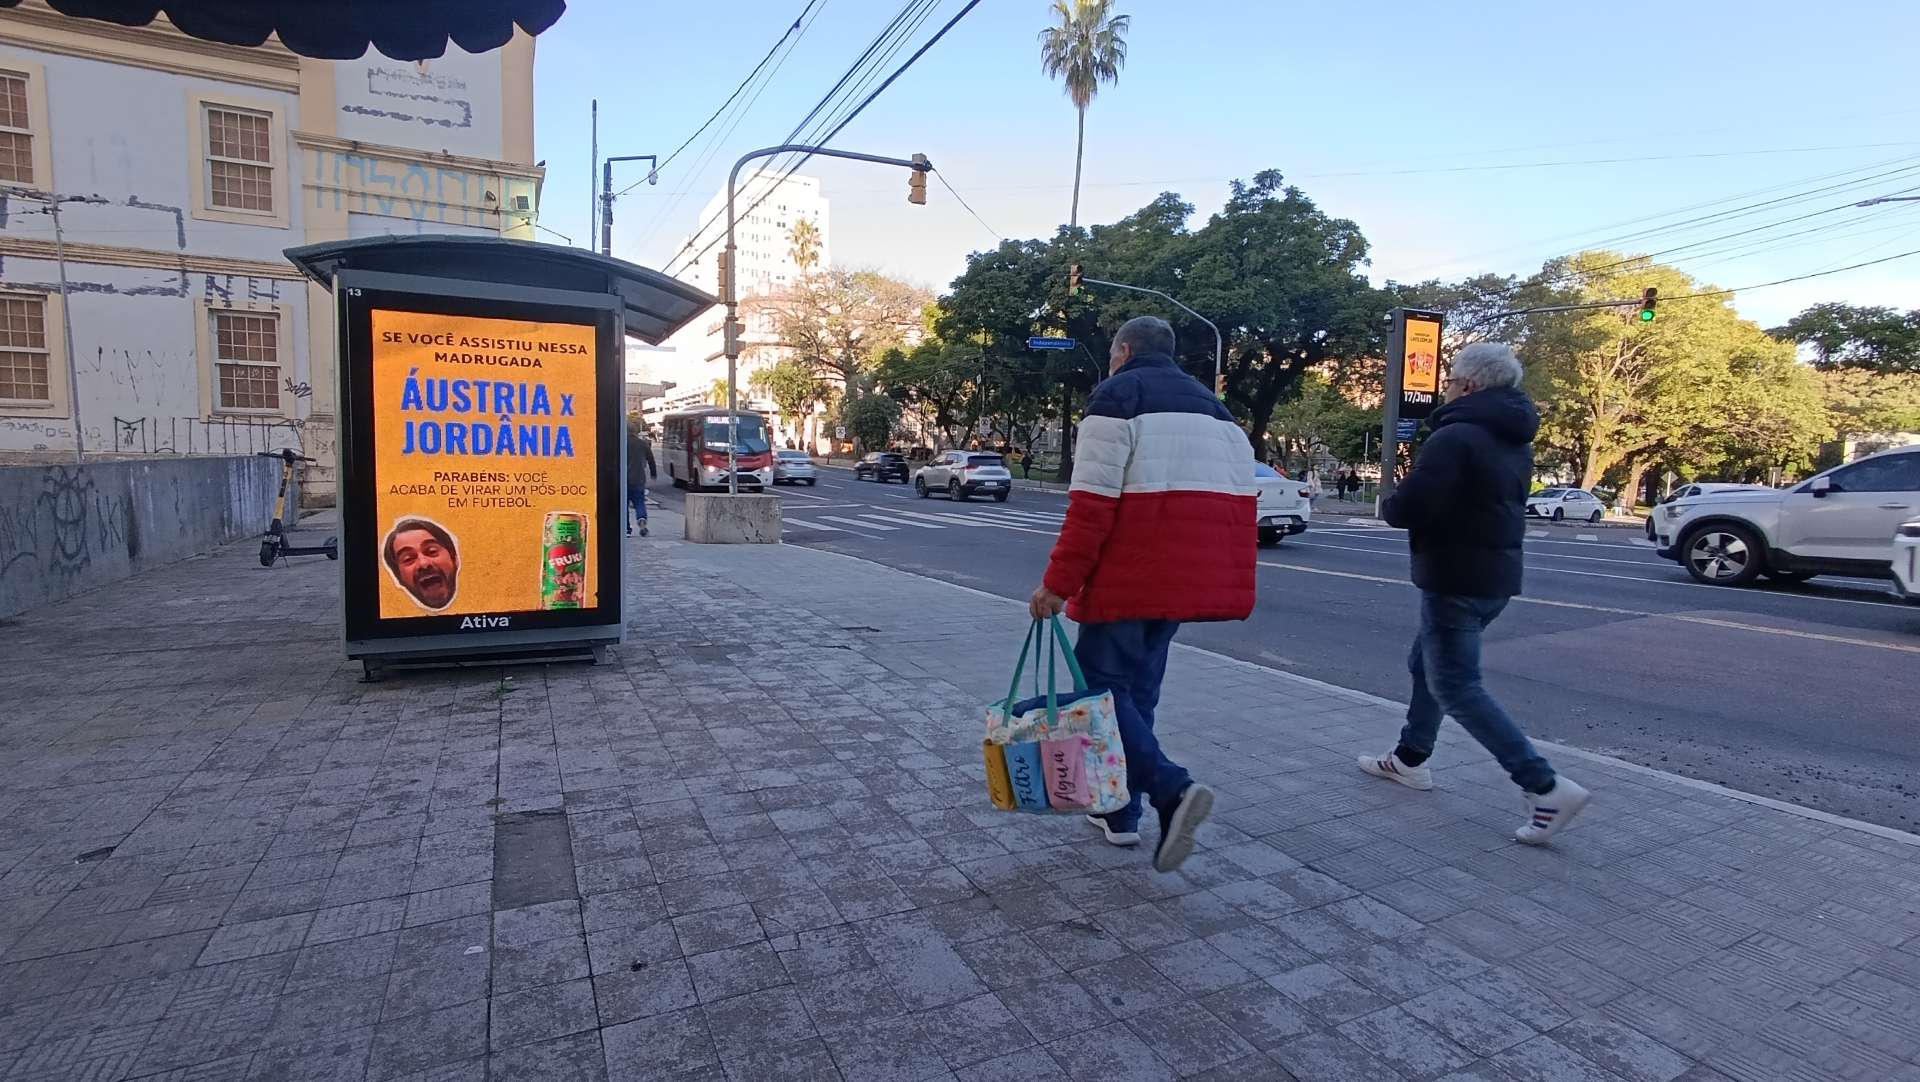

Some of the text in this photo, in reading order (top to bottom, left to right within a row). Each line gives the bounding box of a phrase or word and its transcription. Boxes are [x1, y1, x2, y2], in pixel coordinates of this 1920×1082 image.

[347, 287, 362, 297] 13
[382, 331, 588, 355] SE VOCÊ ASSISTIU NESSA
[434, 352, 543, 368] MADRUGADA
[400, 366, 551, 416] ÁUSTRIA
[1404, 390, 1432, 404] 17/Jun
[402, 414, 574, 457] JORDÂNIA
[434, 470, 548, 483] PARABÉNS: VOCÊ
[389, 482, 587, 496] ACABA DE VIRAR UM PÓS-DOC
[448, 497, 536, 508] EM FUTEBOL.
[548, 552, 583, 568] FRUKI
[460, 615, 510, 630] Ativa
[1014, 755, 1037, 805] Filtro
